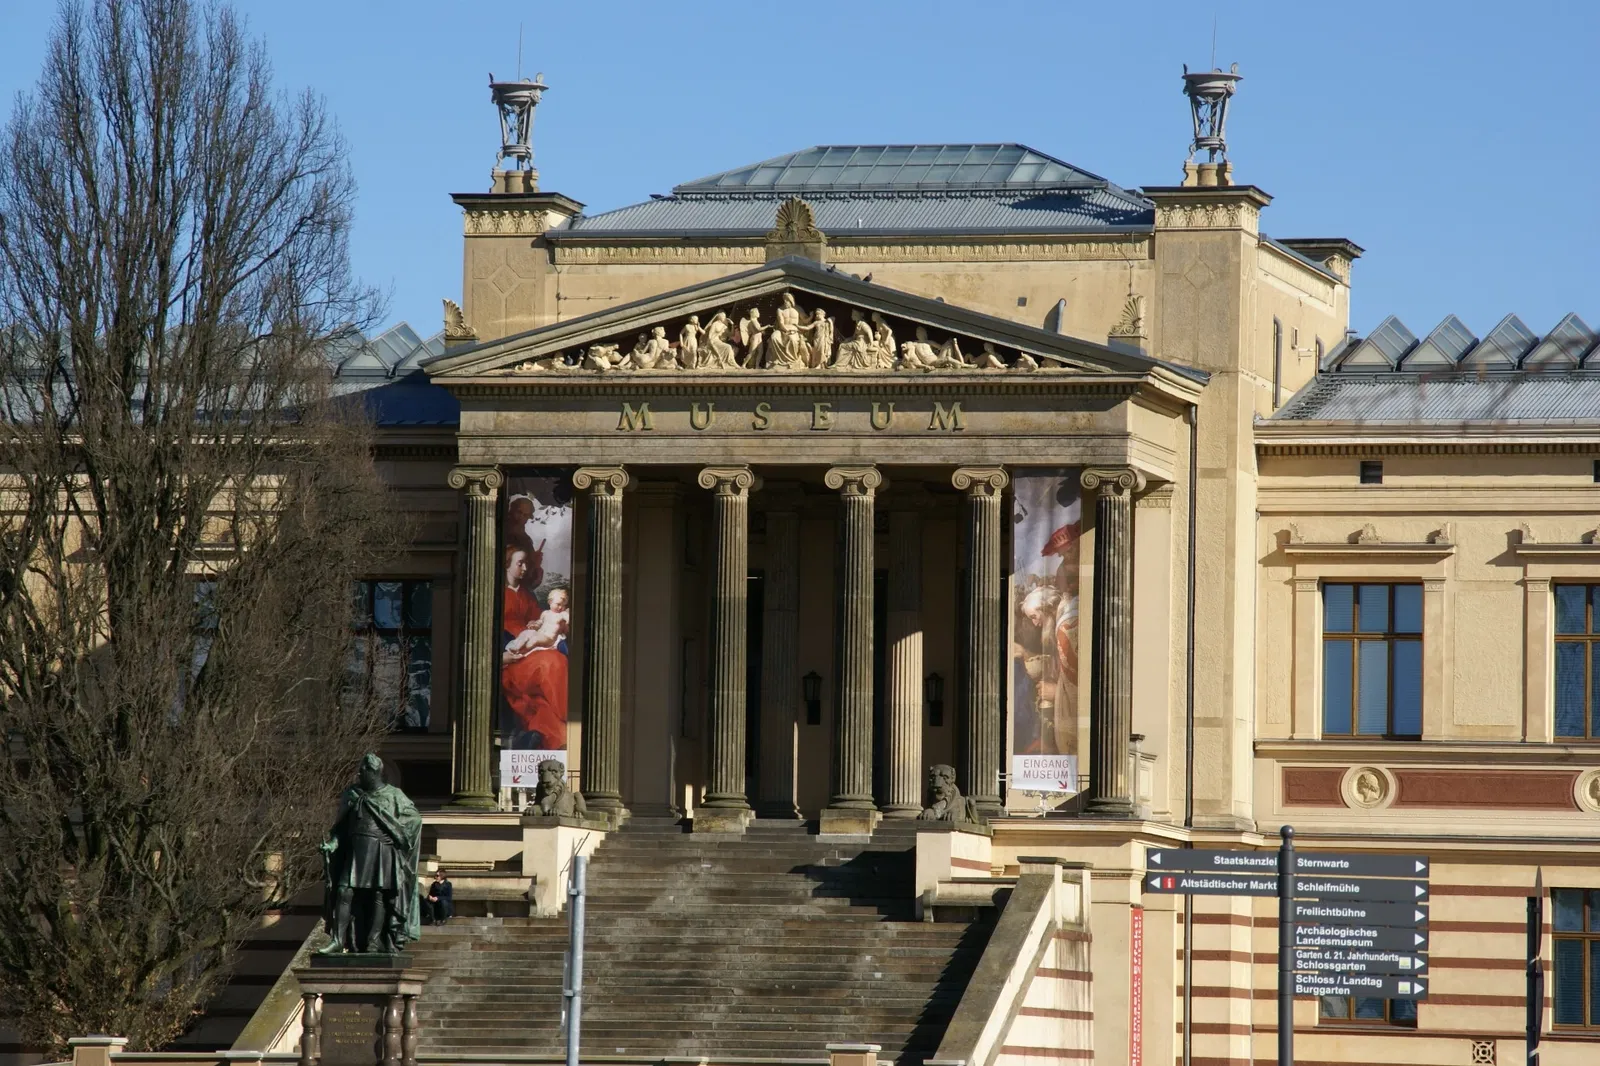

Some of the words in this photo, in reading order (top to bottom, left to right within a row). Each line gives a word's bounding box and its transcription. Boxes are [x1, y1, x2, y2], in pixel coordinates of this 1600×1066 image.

[615, 402, 967, 431] MUSEUM
[511, 754, 557, 763] EINGANG
[1023, 759, 1069, 768] EINGANG
[511, 765, 539, 774] MUSE
[1023, 770, 1069, 780] MUSEUM
[1213, 855, 1278, 866] Staatskanzlei
[1297, 858, 1350, 868] Sternwarte
[1180, 879, 1248, 889] Altstädtischer
[1249, 880, 1277, 890] Markt
[1297, 882, 1360, 893] Schleifmühle
[1296, 906, 1366, 917] Freilichtbühne
[1296, 926, 1378, 938] Archäologisches
[1296, 936, 1373, 947] Landesmuseum
[1296, 950, 1323, 960] Garten
[1324, 951, 1332, 960] d.
[1333, 951, 1345, 960] 21.
[1347, 952, 1399, 962] Jahrhunderts
[1296, 960, 1366, 972] Schlossgarten
[1296, 974, 1335, 984] Schloss
[1343, 976, 1383, 988] Landtag
[1296, 984, 1350, 996] Burggarten
